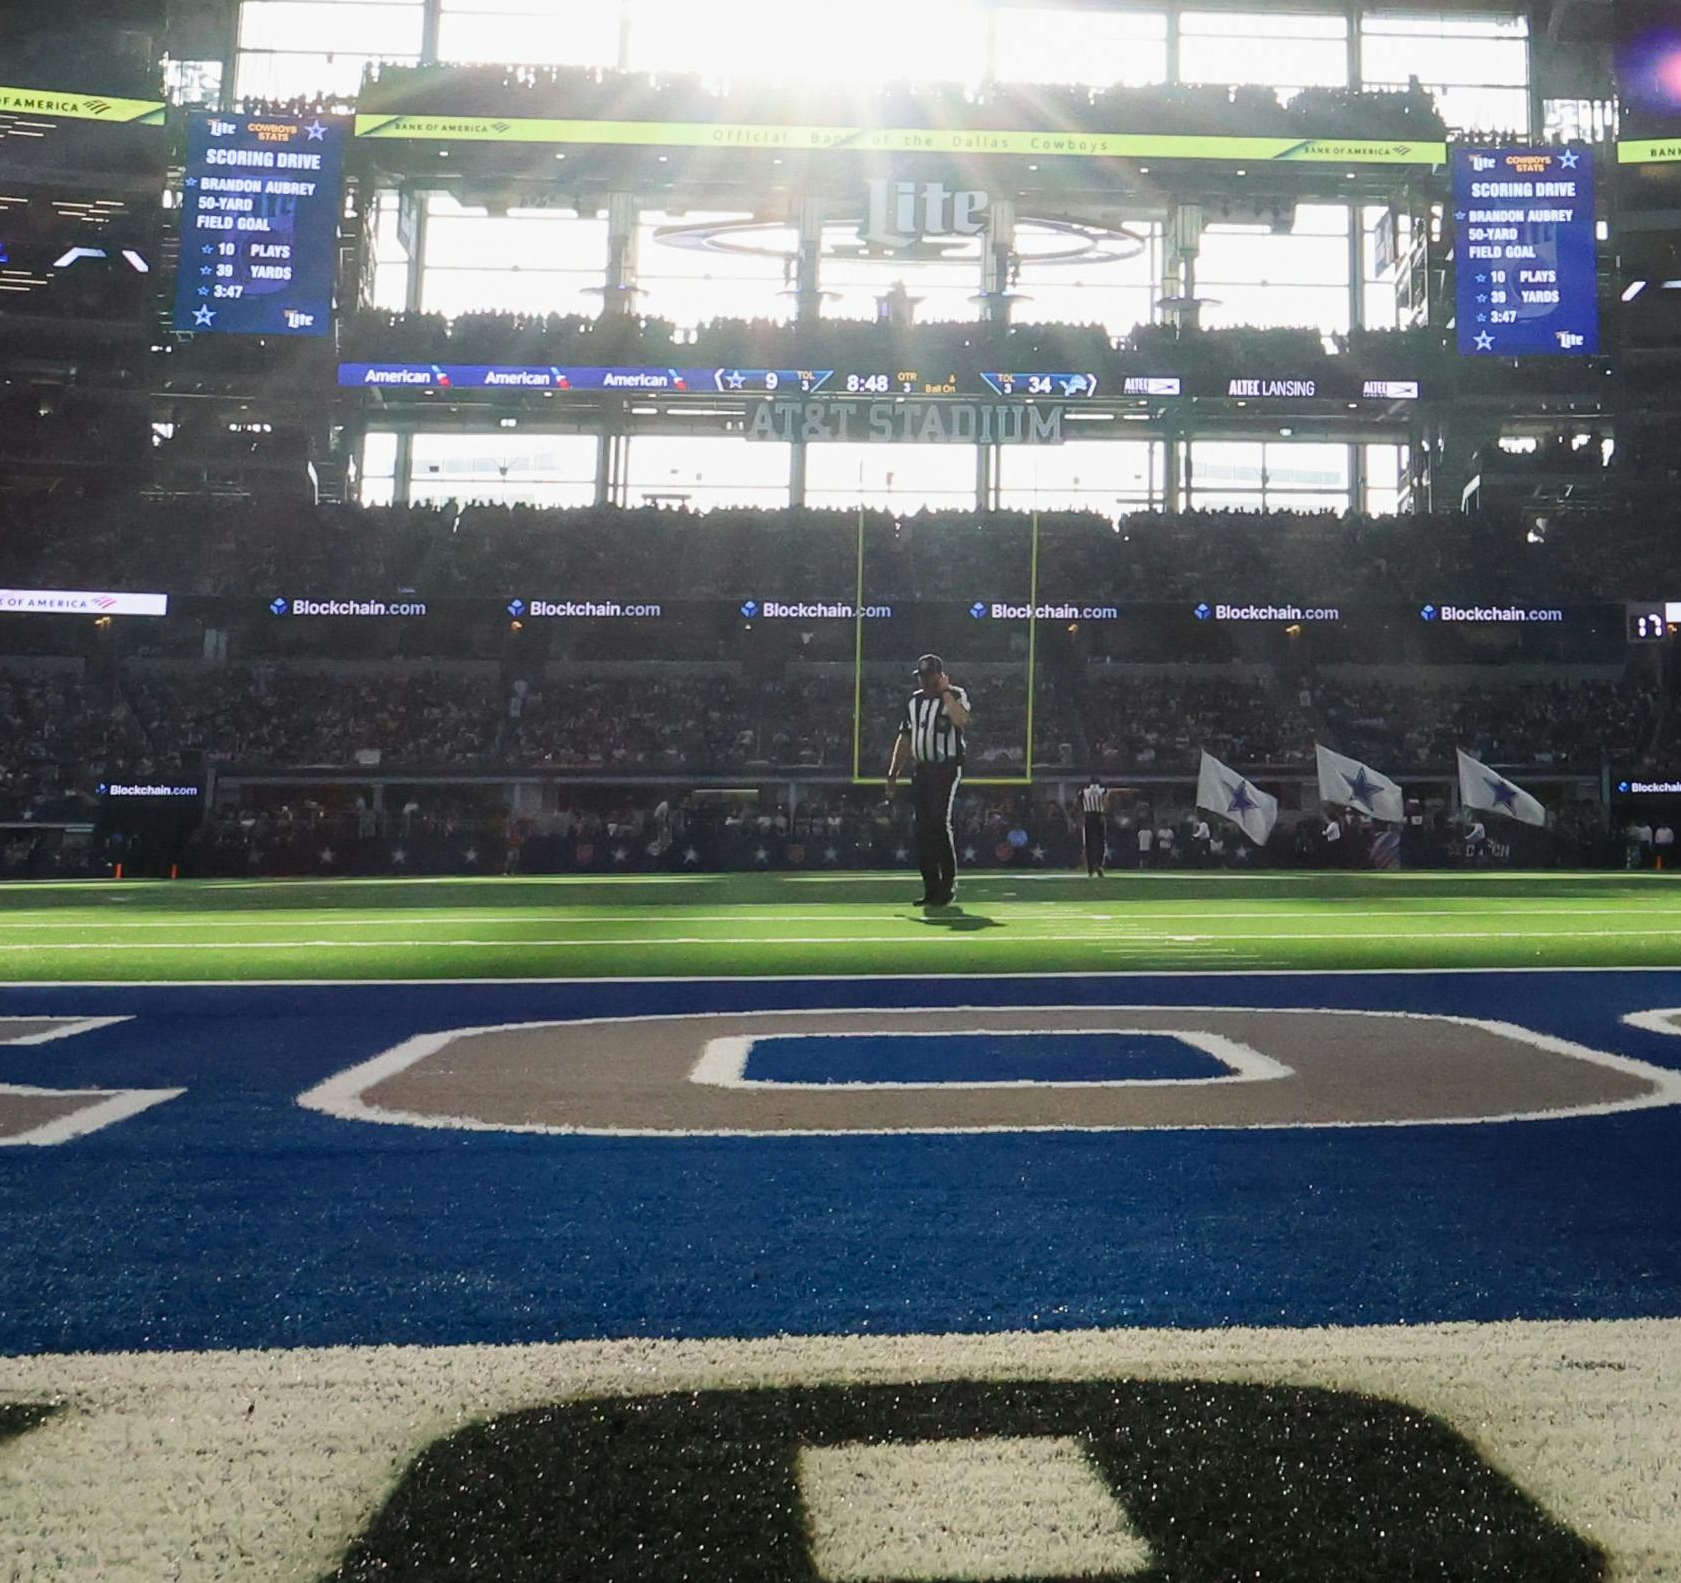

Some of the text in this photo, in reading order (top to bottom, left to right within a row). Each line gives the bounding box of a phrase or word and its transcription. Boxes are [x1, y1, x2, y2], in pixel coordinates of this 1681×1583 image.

[13, 97, 80, 113] AMERICA
[247, 123, 297, 134] COWBOYS
[394, 122, 488, 133] BANK OF AMERICA
[258, 132, 290, 142] STATS
[712, 128, 789, 144] Official
[871, 133, 892, 148] of
[902, 133, 934, 148] the
[952, 135, 1010, 150] Dallas
[1030, 136, 1110, 155] Cowboys
[206, 149, 321, 169] SCORING DRIVE
[1304, 146, 1392, 157] BANK OF AMERICA
[1505, 155, 1551, 165] COWBOYS
[1516, 163, 1544, 172] STATS
[200, 177, 316, 196] BRANDON AUBREY
[1471, 182, 1576, 198] SCORING DRIVE
[198, 196, 253, 211] 50-YARD
[861, 178, 990, 248] Lite
[1468, 209, 1574, 223] BRANDON AUBREY
[196, 215, 270, 231] FIELD GOAL
[1468, 227, 1518, 240] 50-YARD
[218, 242, 291, 259] 10 PLAYS
[1469, 245, 1536, 258] FIELD GOAL
[216, 264, 292, 280] 39 YARDS
[1490, 270, 1556, 283] 10 PLAYS
[213, 284, 243, 298] 3:47
[1490, 290, 1560, 304] 39 YARDS
[1490, 310, 1517, 323] 3:47
[365, 369, 431, 385] American
[484, 370, 550, 386] American
[603, 372, 668, 387] American
[765, 372, 778, 390] 9
[797, 370, 815, 380] TOL
[998, 374, 1016, 383] TOL
[801, 380, 809, 391] 3
[846, 374, 889, 392] 8:48
[903, 382, 911, 393] 3
[1004, 383, 1012, 394] 3
[1028, 376, 1052, 393] 34
[1124, 377, 1149, 391] ALTEC
[1229, 380, 1316, 397] ALTEC LANSING
[1363, 381, 1387, 394] ALTEC
[747, 402, 1065, 444] AT&T STADIUM
[7, 598, 23, 606] OF
[27, 599, 88, 608] AMERICA
[292, 598, 427, 616] Blockchain.com
[529, 600, 661, 618] Blockchain.com
[762, 601, 892, 619] Blockchain.com
[990, 602, 1118, 620] Blockchain.com
[1215, 603, 1340, 621] Blockchain.com
[1440, 605, 1563, 622] Blockchain.com
[110, 785, 198, 796] Blockchain.com
